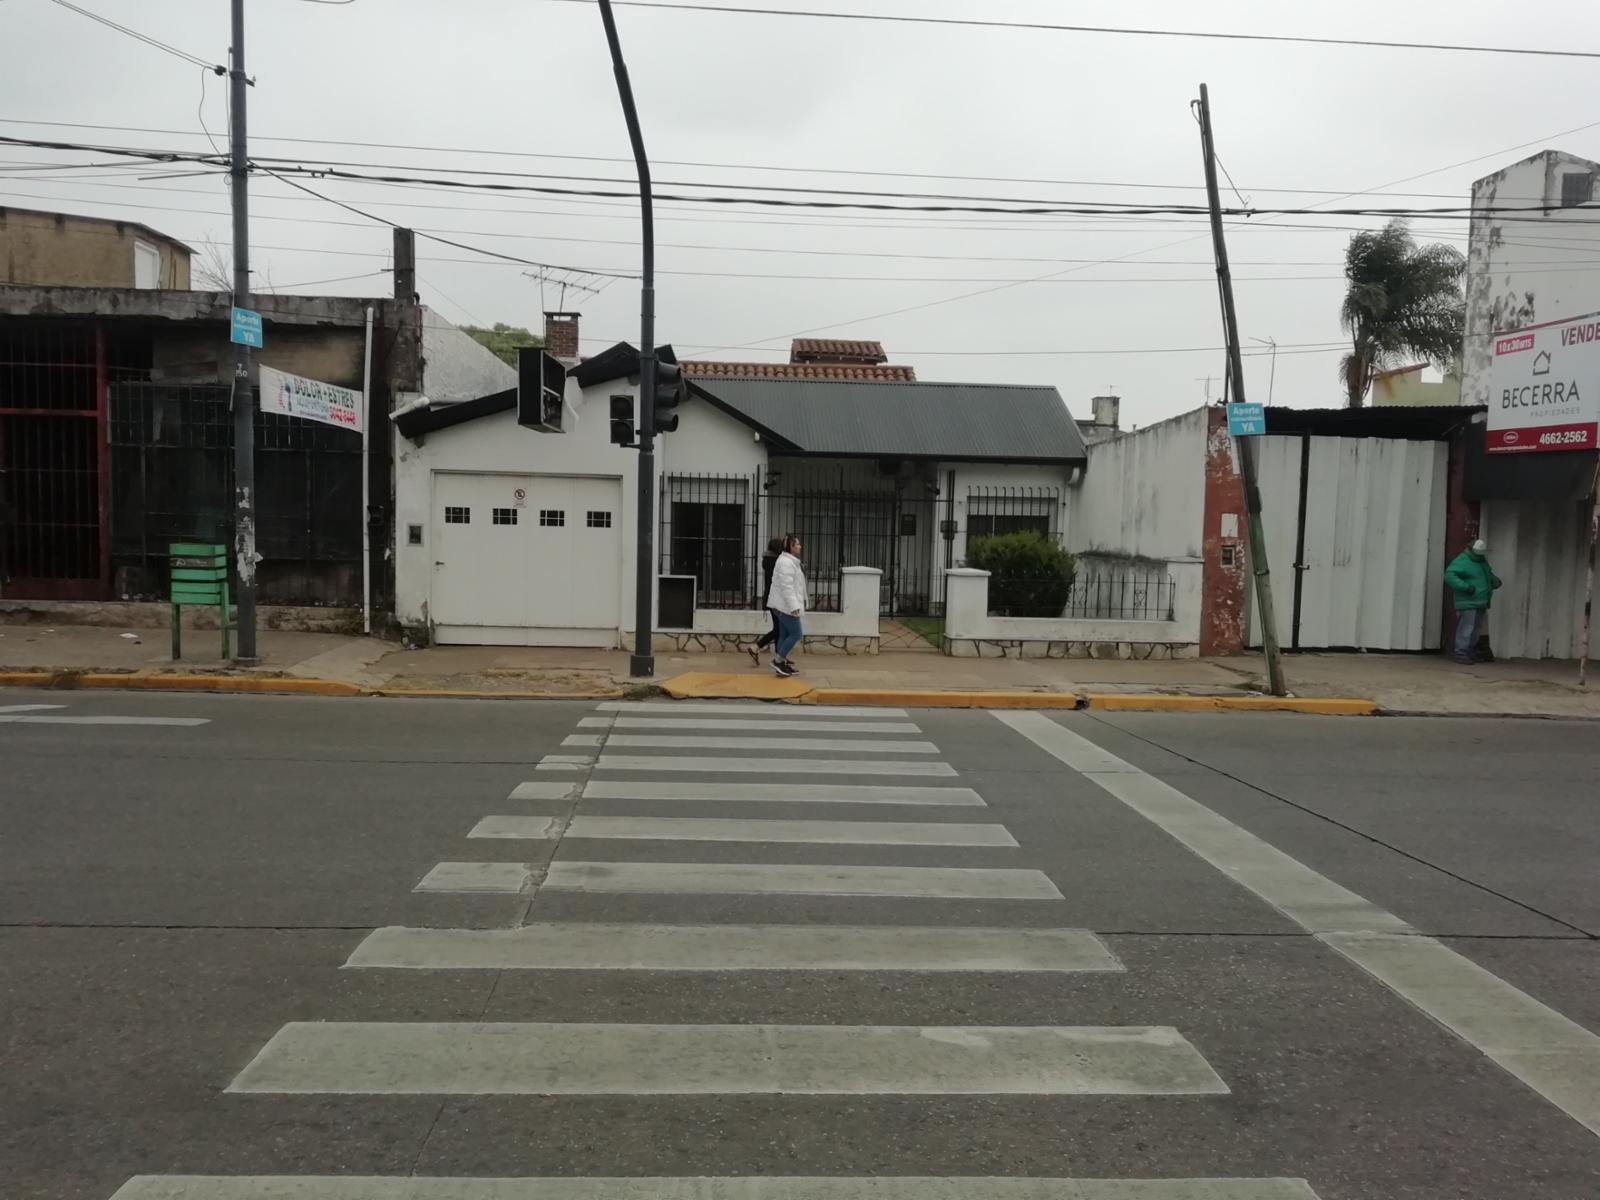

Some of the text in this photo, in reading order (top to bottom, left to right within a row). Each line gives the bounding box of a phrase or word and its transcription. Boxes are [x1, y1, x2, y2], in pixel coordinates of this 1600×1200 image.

[294, 377, 322, 400] DOLOR
[328, 386, 354, 409] ESTRES
[1502, 380, 1580, 409] BECERRA
[1241, 421, 1255, 432] YA
[1540, 431, 1588, 444] 4662-2562
